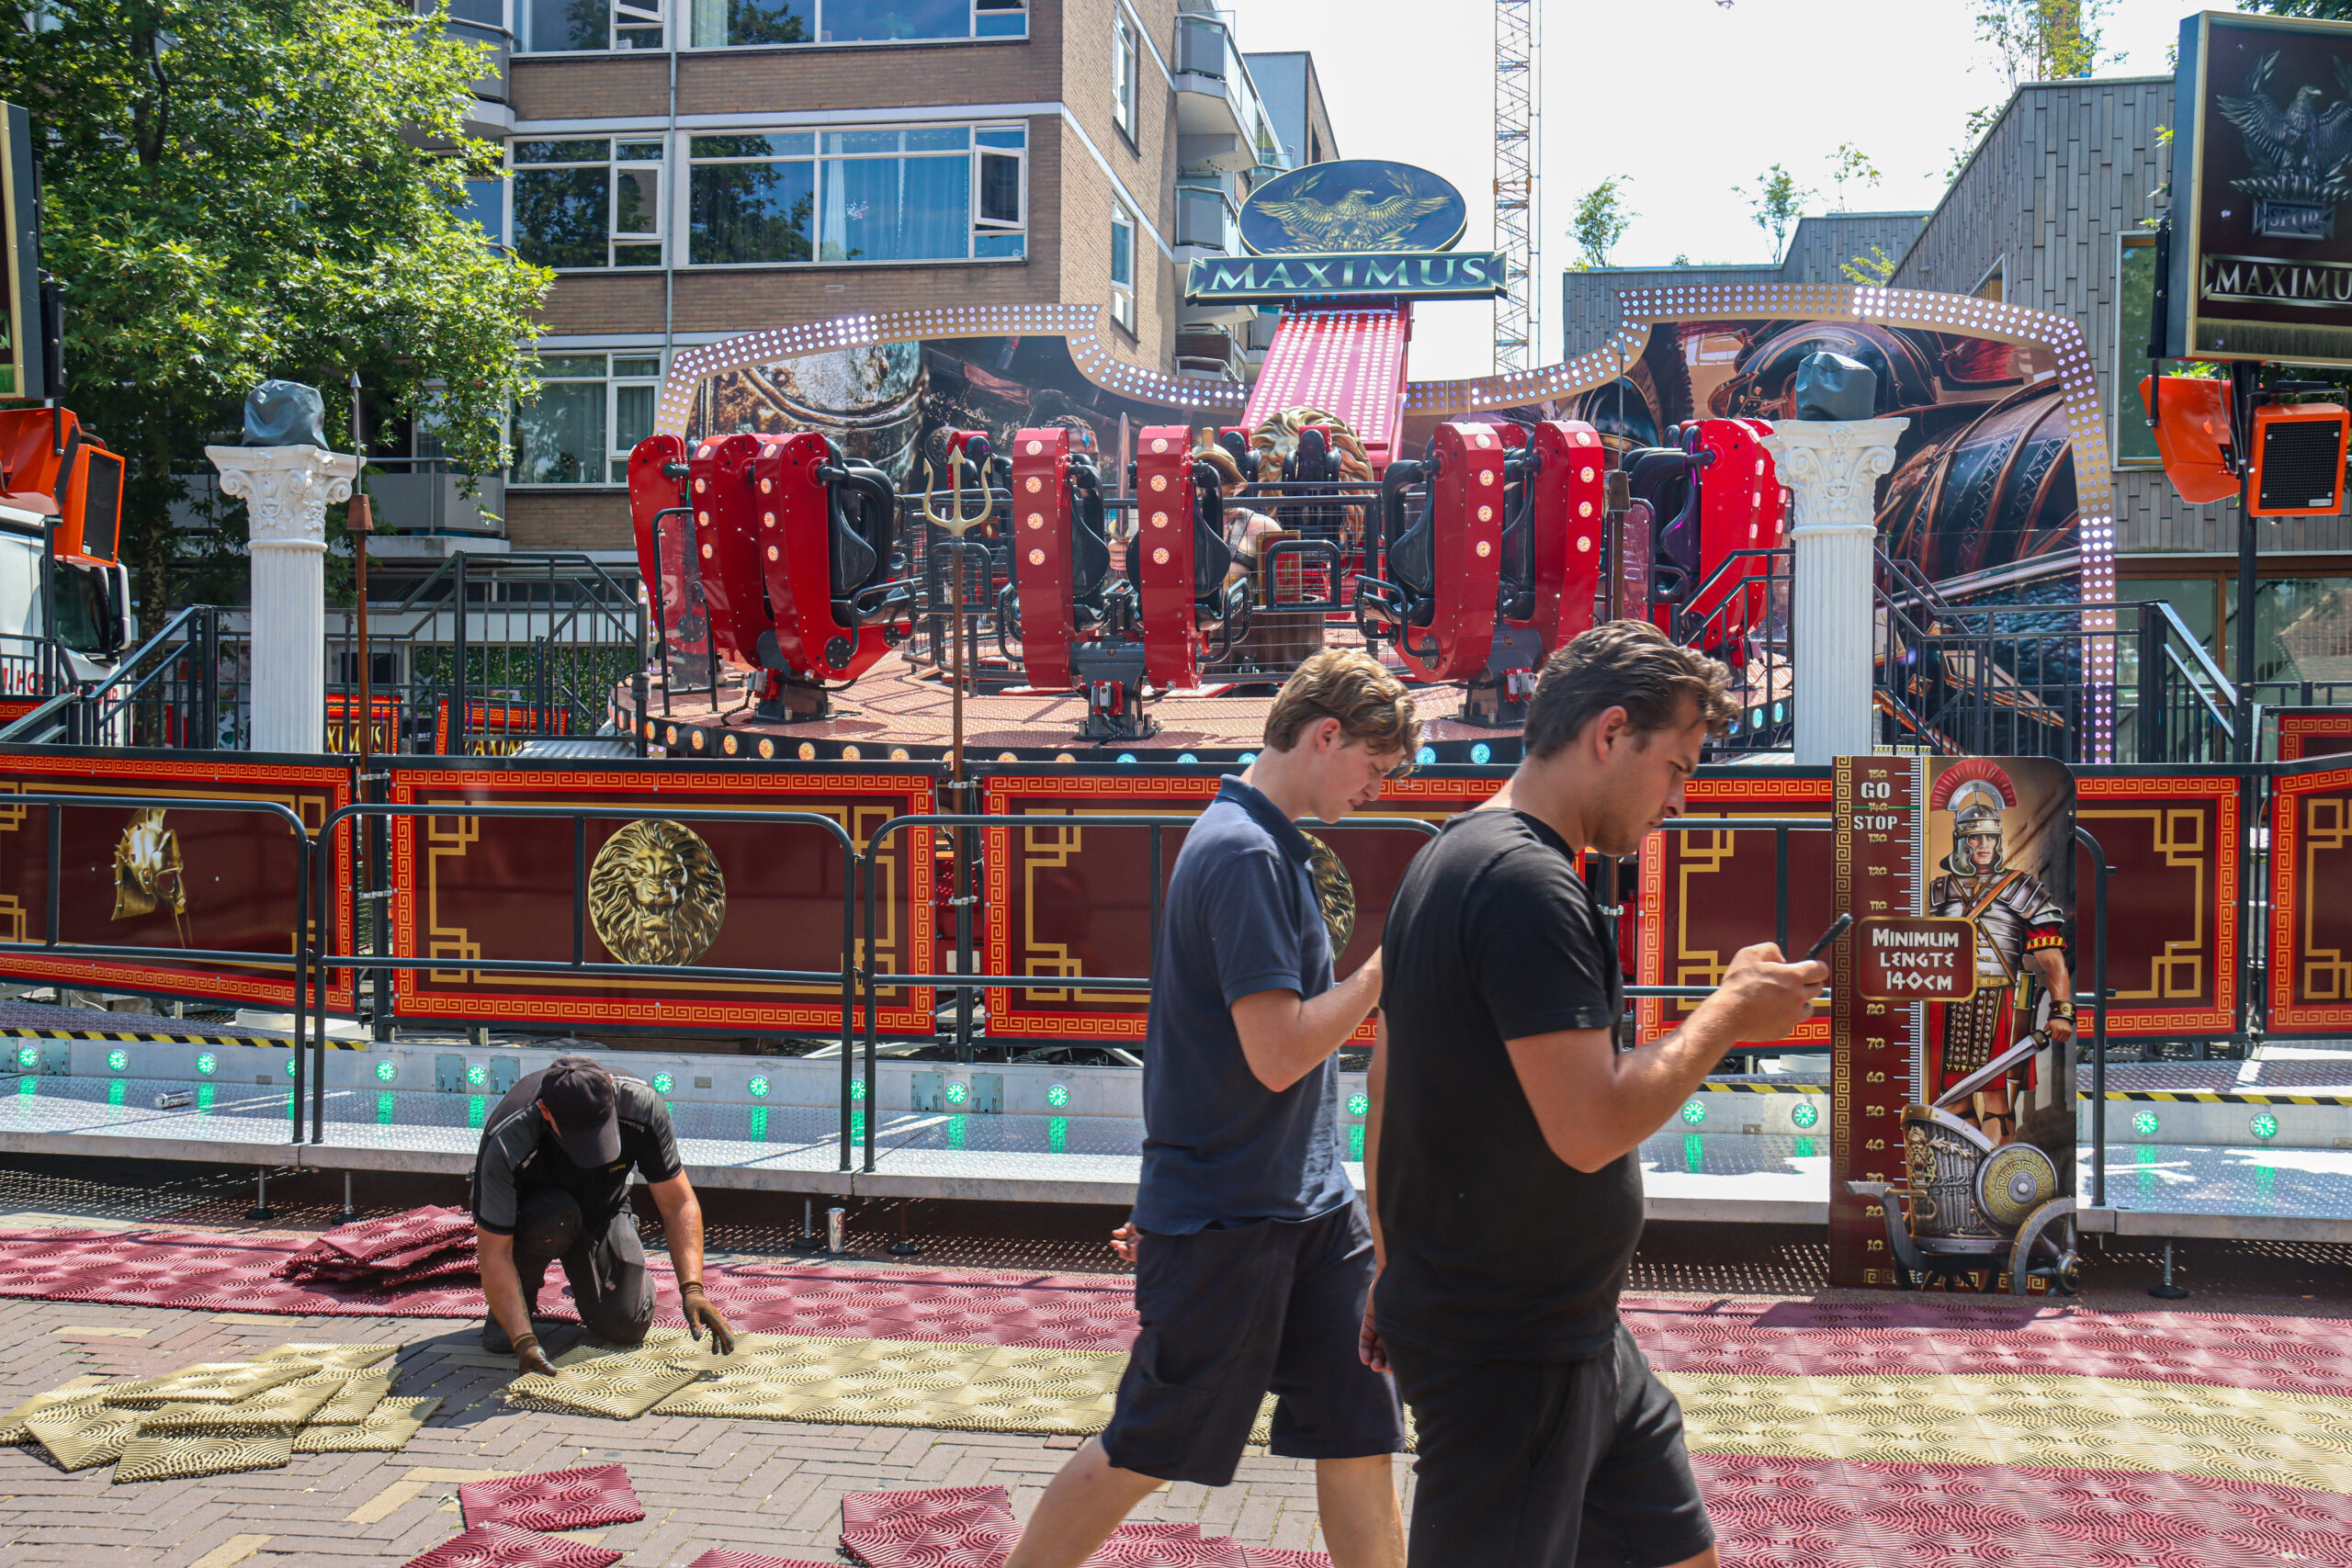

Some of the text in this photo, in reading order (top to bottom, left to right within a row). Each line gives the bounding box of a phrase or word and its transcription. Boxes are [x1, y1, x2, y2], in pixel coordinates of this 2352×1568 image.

[2268, 207, 2327, 234] SPQR
[1207, 257, 1487, 291] MAXIMUS
[1860, 782, 1891, 799] GO
[1853, 815, 1898, 830] STOP
[1868, 866, 1888, 876] 120
[1870, 900, 1888, 911] 110
[1872, 928, 1960, 948] MINIMUM
[1880, 951, 1955, 968] LENGTE
[1866, 1003, 1885, 1016] 80
[1866, 1037, 1885, 1050] 70
[1866, 1071, 1885, 1084] 60
[1866, 1105, 1885, 1118] 50
[1865, 1139, 1884, 1151] 40
[1866, 1205, 1884, 1218] 20
[1867, 1239, 1883, 1251] 10
